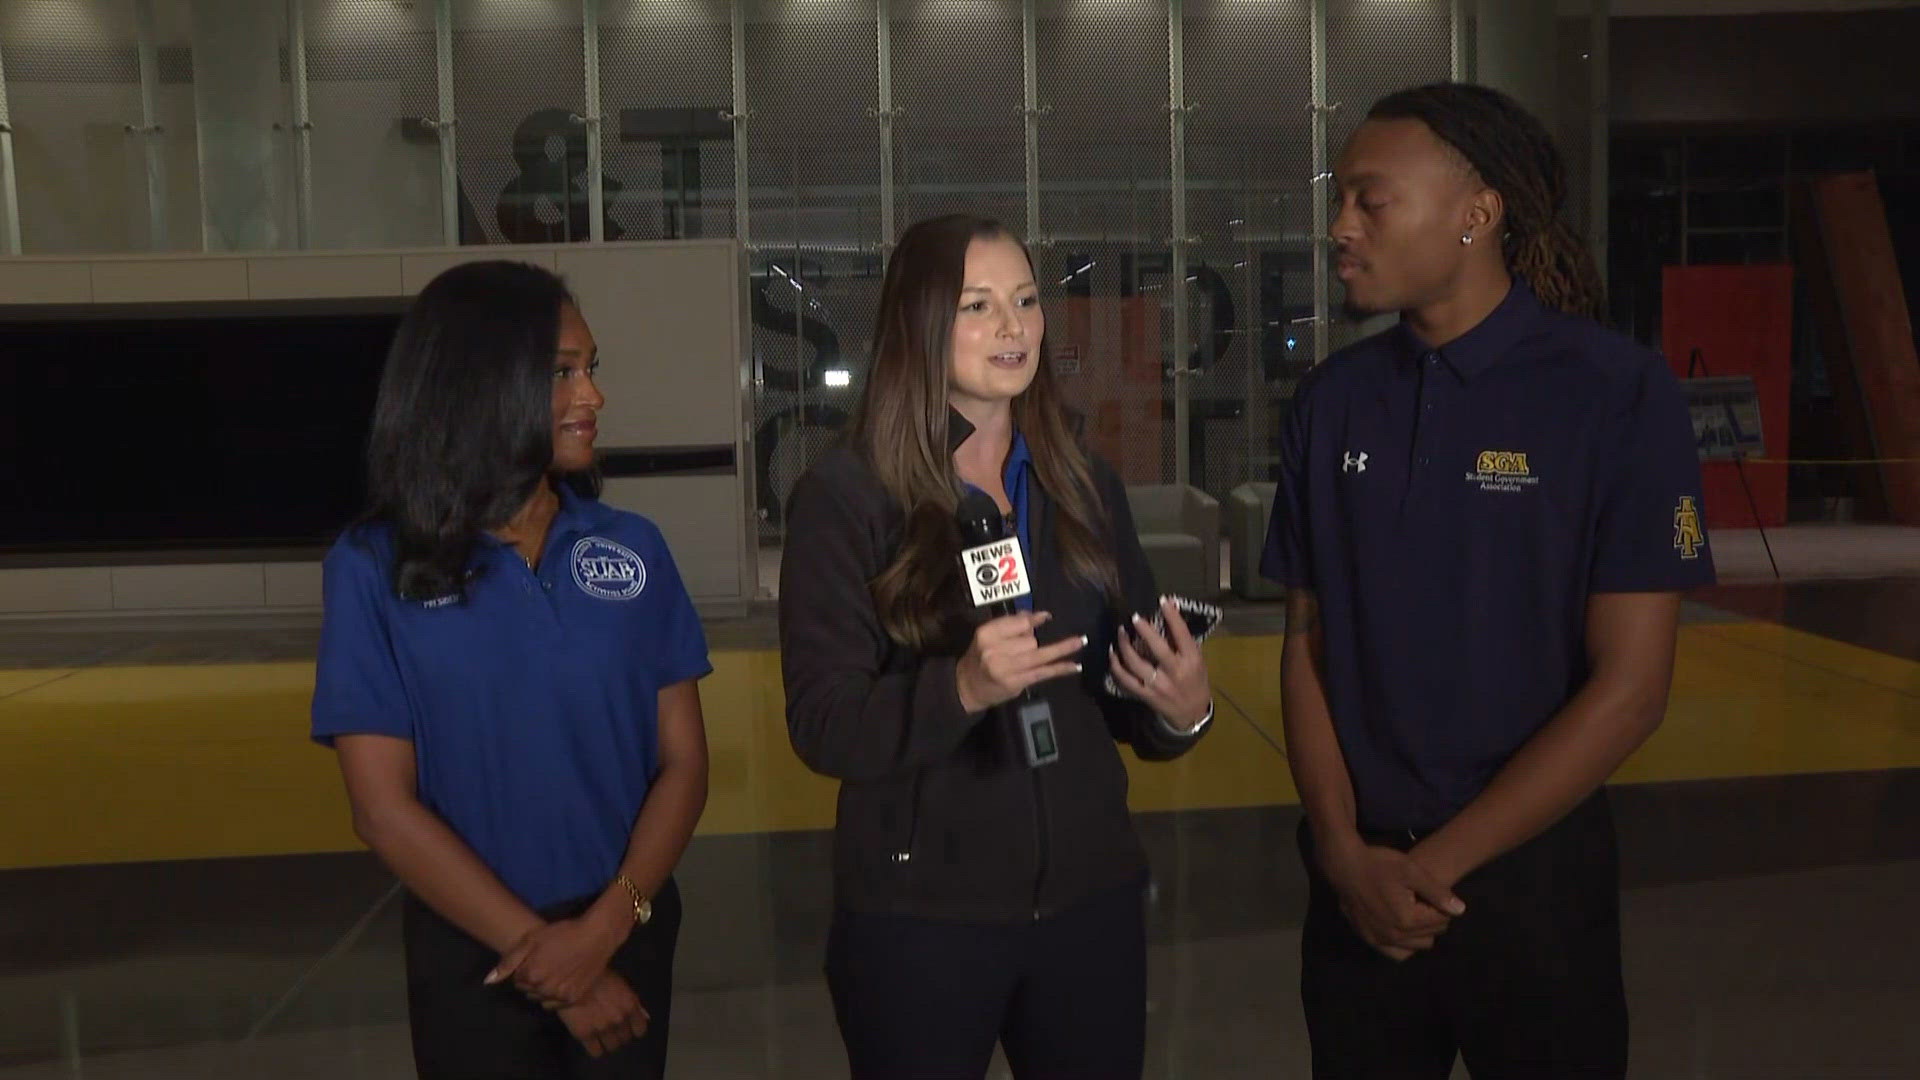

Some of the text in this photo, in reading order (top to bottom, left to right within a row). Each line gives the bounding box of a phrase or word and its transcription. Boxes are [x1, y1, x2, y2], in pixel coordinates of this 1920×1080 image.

[1478, 451, 1529, 474] SGA
[1465, 471, 1539, 485] Student Government
[1480, 481, 1521, 492] Association
[970, 543, 1013, 565] NEWS
[580, 558, 636, 580] SUAB
[998, 555, 1018, 584] 2
[980, 579, 1021, 601] WFMY
